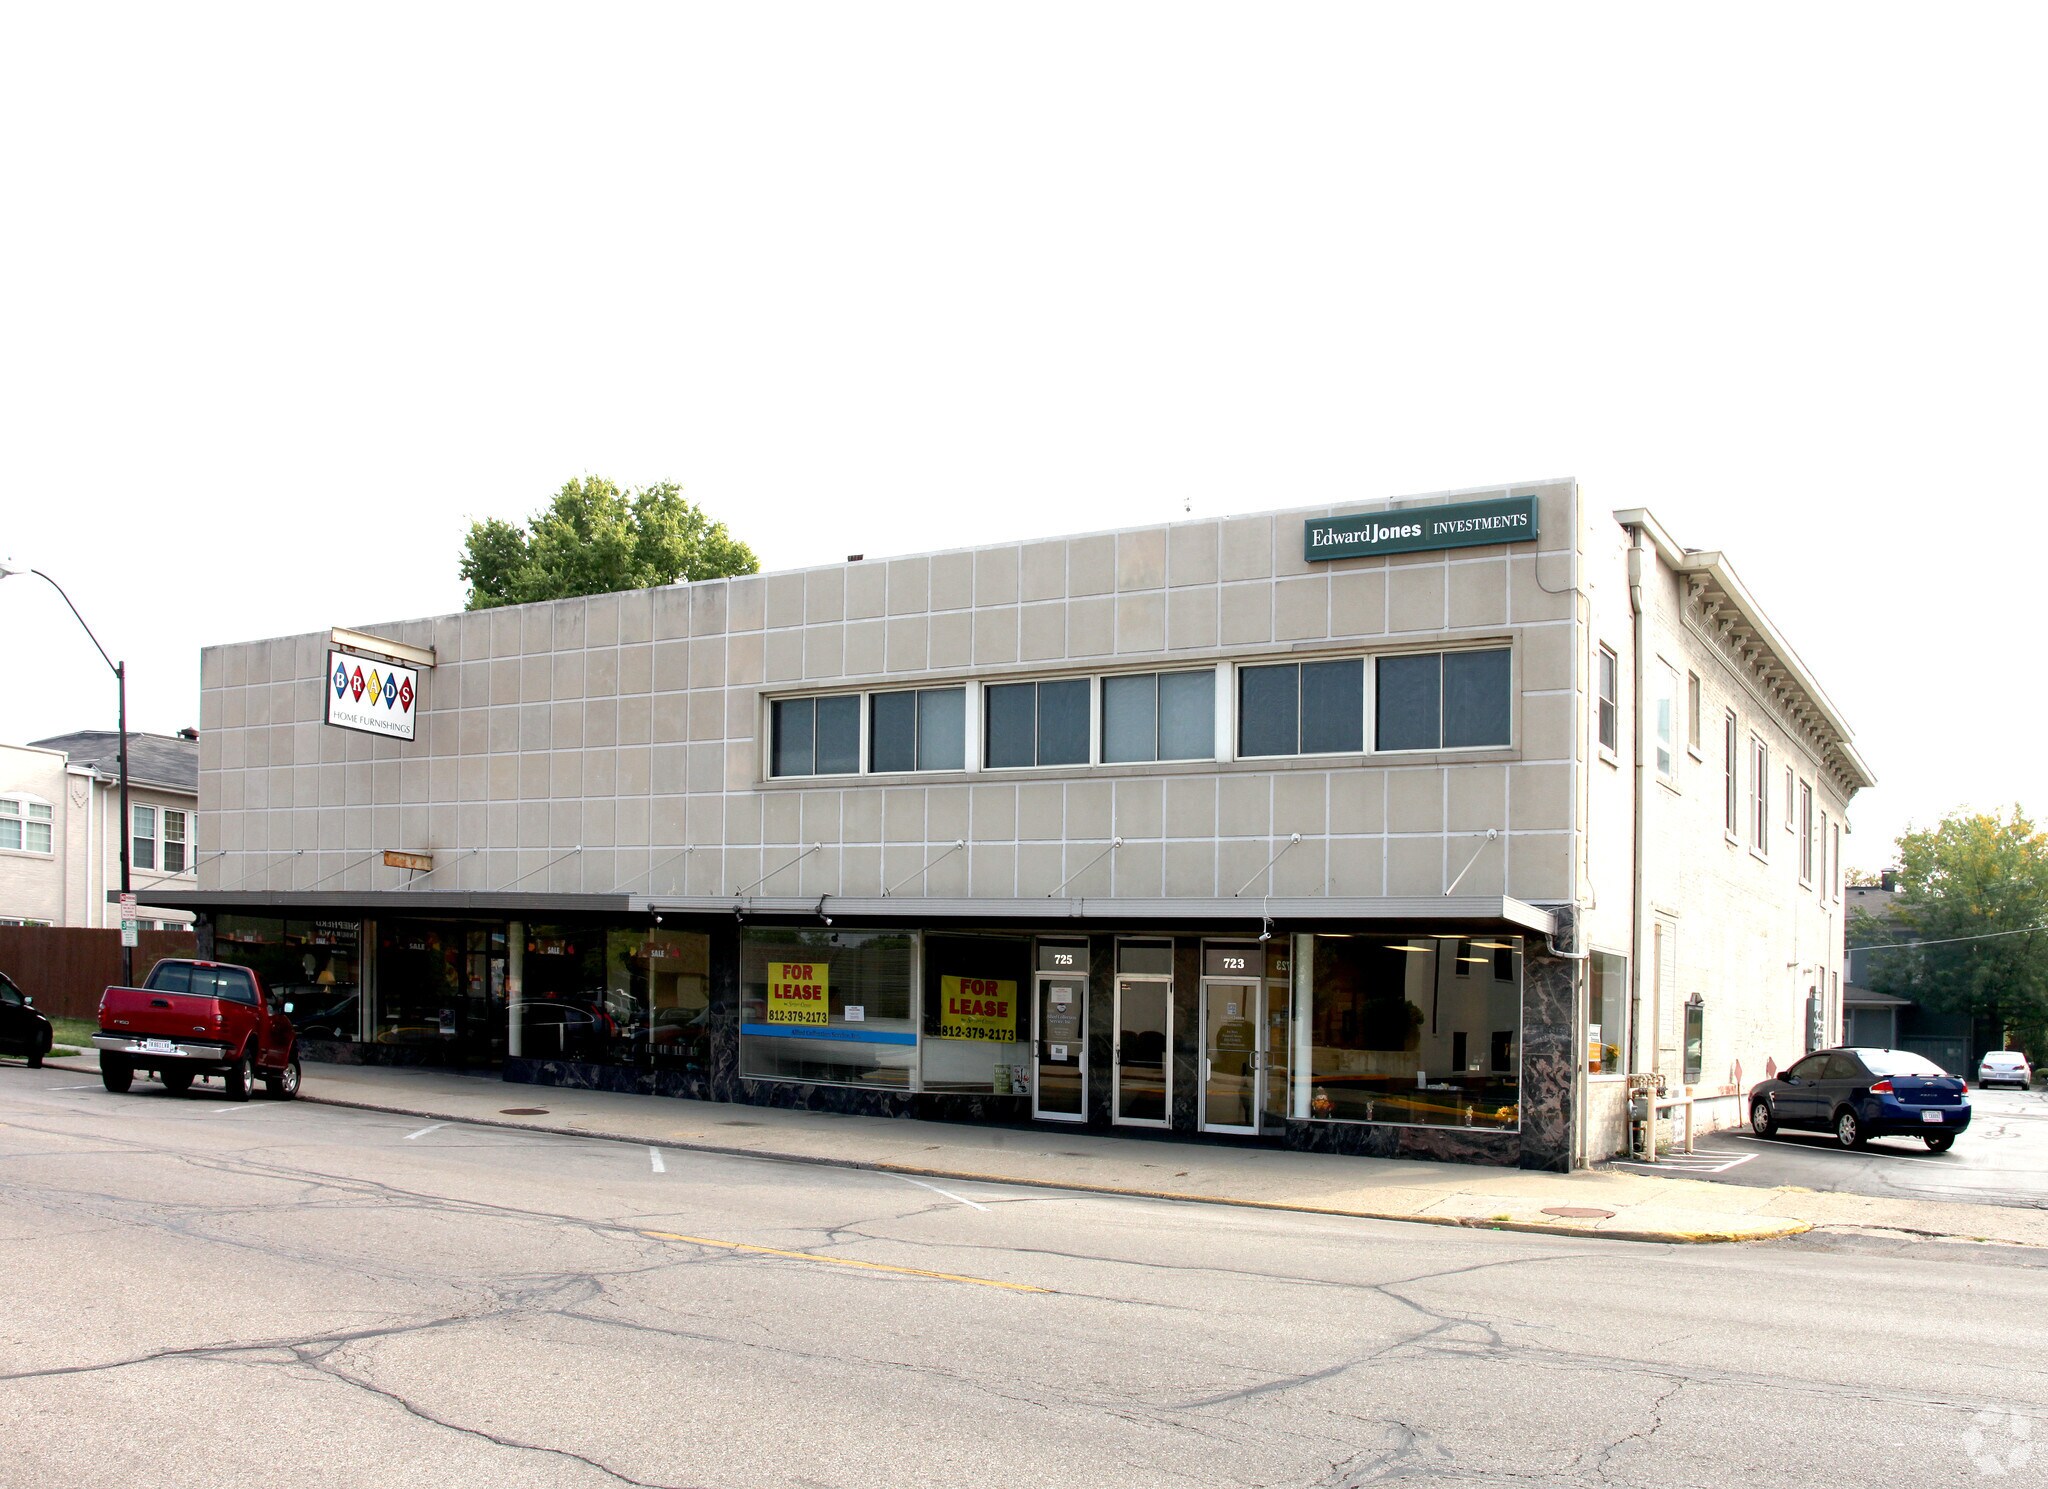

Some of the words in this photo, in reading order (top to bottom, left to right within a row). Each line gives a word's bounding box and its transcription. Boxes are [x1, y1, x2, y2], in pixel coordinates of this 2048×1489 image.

[1433, 513, 1528, 535] INVESTMENTS
[335, 672, 410, 702] BRADS
[333, 710, 358, 724] HOME
[359, 715, 411, 734] FURNISHINGS
[408, 942, 426, 951] SALE
[547, 946, 561, 955] SALE
[650, 949, 665, 958] SALE
[1054, 954, 1073, 965] 725
[1223, 958, 1245, 969] 723
[782, 963, 814, 981] FOR
[774, 983, 822, 1001] LEASE
[960, 978, 998, 997] FOR
[949, 997, 1009, 1018] LEASE
[768, 1009, 827, 1024] 812-379-2173
[941, 1025, 1015, 1041] 812-379-2173
